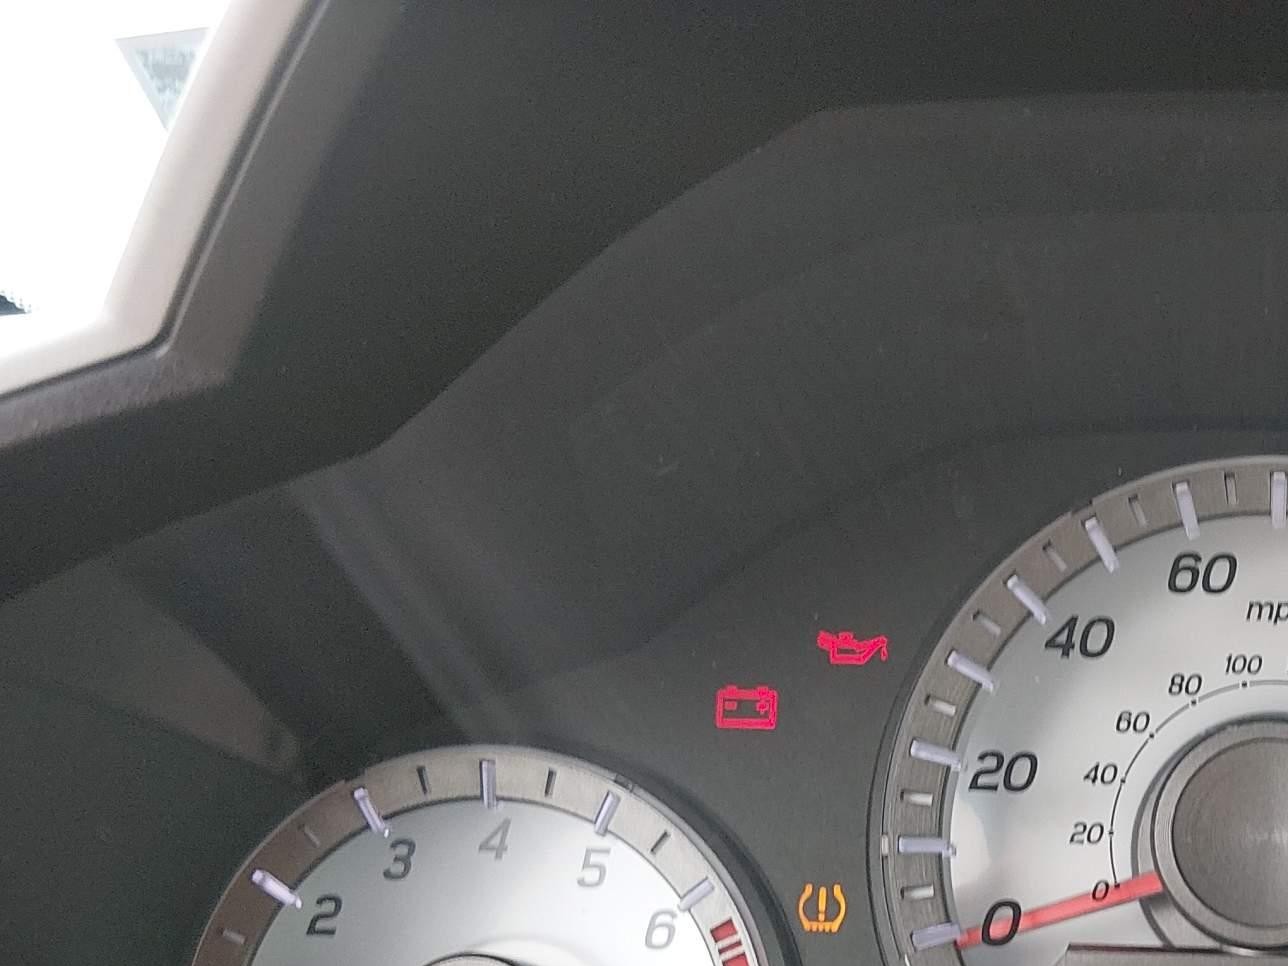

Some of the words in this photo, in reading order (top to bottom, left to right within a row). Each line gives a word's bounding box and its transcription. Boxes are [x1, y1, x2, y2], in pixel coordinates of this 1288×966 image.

[1167, 553, 1237, 593] 60
[1044, 616, 1115, 658] 40
[1168, 674, 1202, 696] 80
[1224, 655, 1262, 675] 100
[1116, 712, 1150, 734] 60
[968, 751, 1037, 792] 20
[1083, 762, 1118, 785] 40
[479, 817, 511, 860] 4
[1069, 823, 1103, 844] 20
[383, 839, 416, 880] 3
[577, 848, 611, 888] 5
[1091, 881, 1109, 902] 0
[306, 897, 342, 936] 2
[645, 909, 677, 949] 6
[980, 901, 1021, 945] 0
